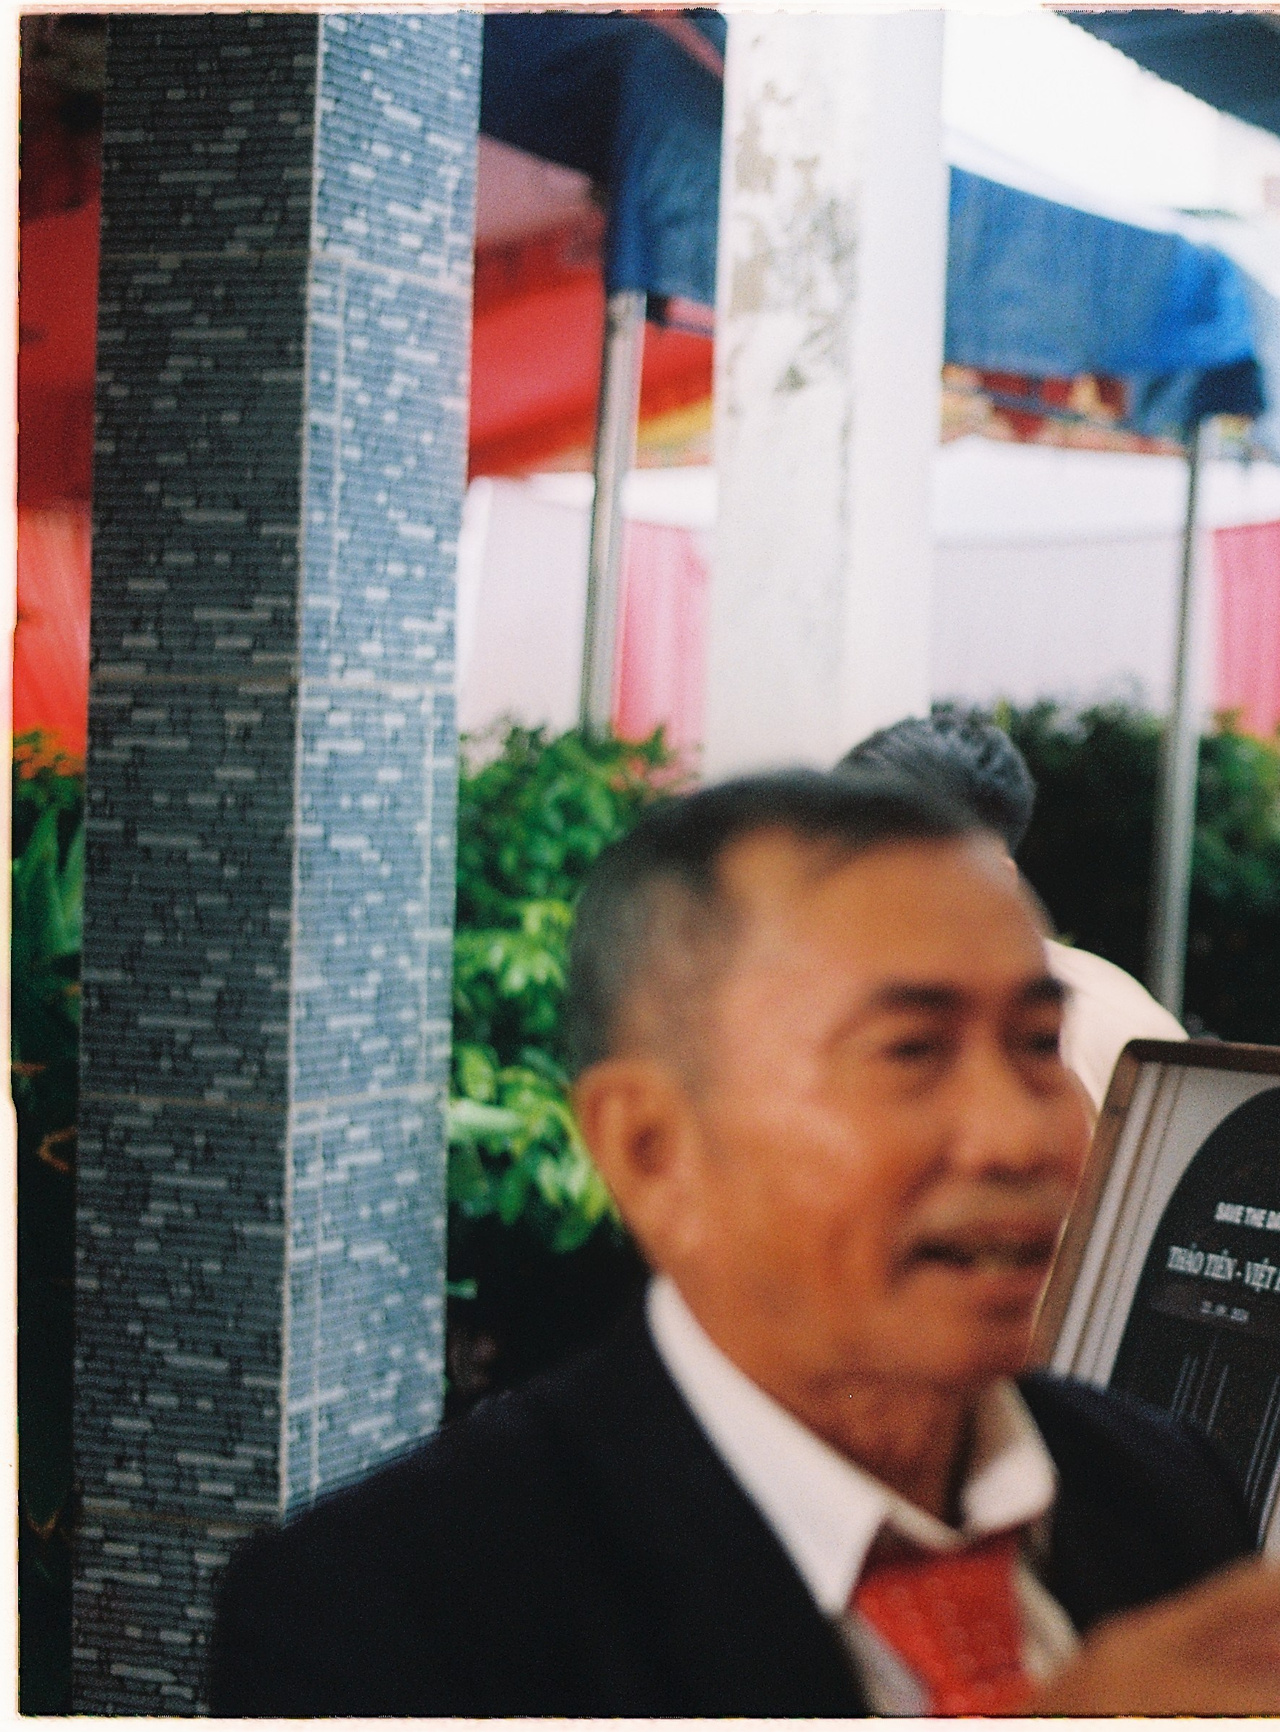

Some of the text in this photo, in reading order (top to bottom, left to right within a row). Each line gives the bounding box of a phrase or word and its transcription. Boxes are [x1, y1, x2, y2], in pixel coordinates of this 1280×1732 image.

[1215, 1201, 1244, 1224] SAVE
[1245, 1206, 1267, 1228] THE
[1244, 1257, 1277, 1293] VIỆT
